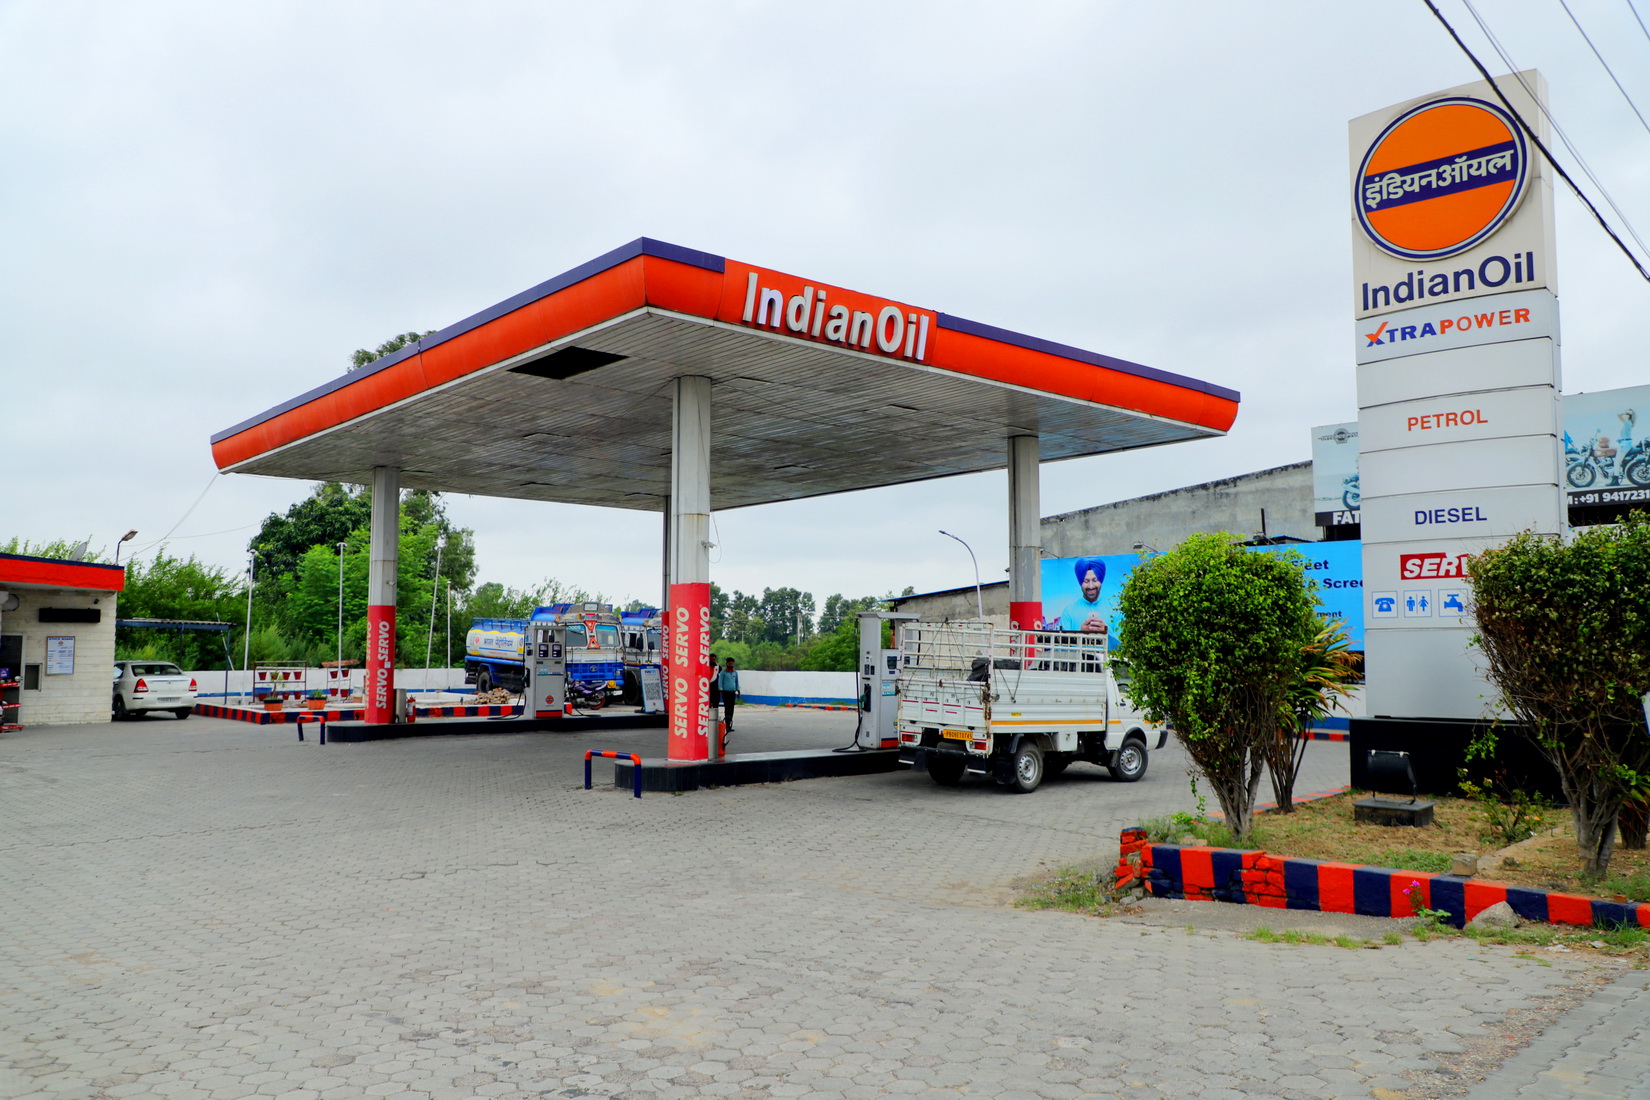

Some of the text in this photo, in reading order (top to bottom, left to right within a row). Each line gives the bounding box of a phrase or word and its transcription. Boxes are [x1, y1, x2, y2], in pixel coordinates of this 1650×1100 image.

[1365, 149, 1515, 210] इंडियनऑयल
[1362, 251, 1535, 311] IndianOil
[742, 271, 930, 361] IndianOil
[1407, 409, 1488, 431] PETROL
[1414, 506, 1488, 525] DIESEL
[378, 621, 390, 661] SERVO
[676, 607, 690, 668] SERVO
[699, 606, 710, 667] SERVO
[376, 668, 388, 709] SERVO
[675, 677, 688, 739] SERVO
[697, 677, 709, 737] SERVO
